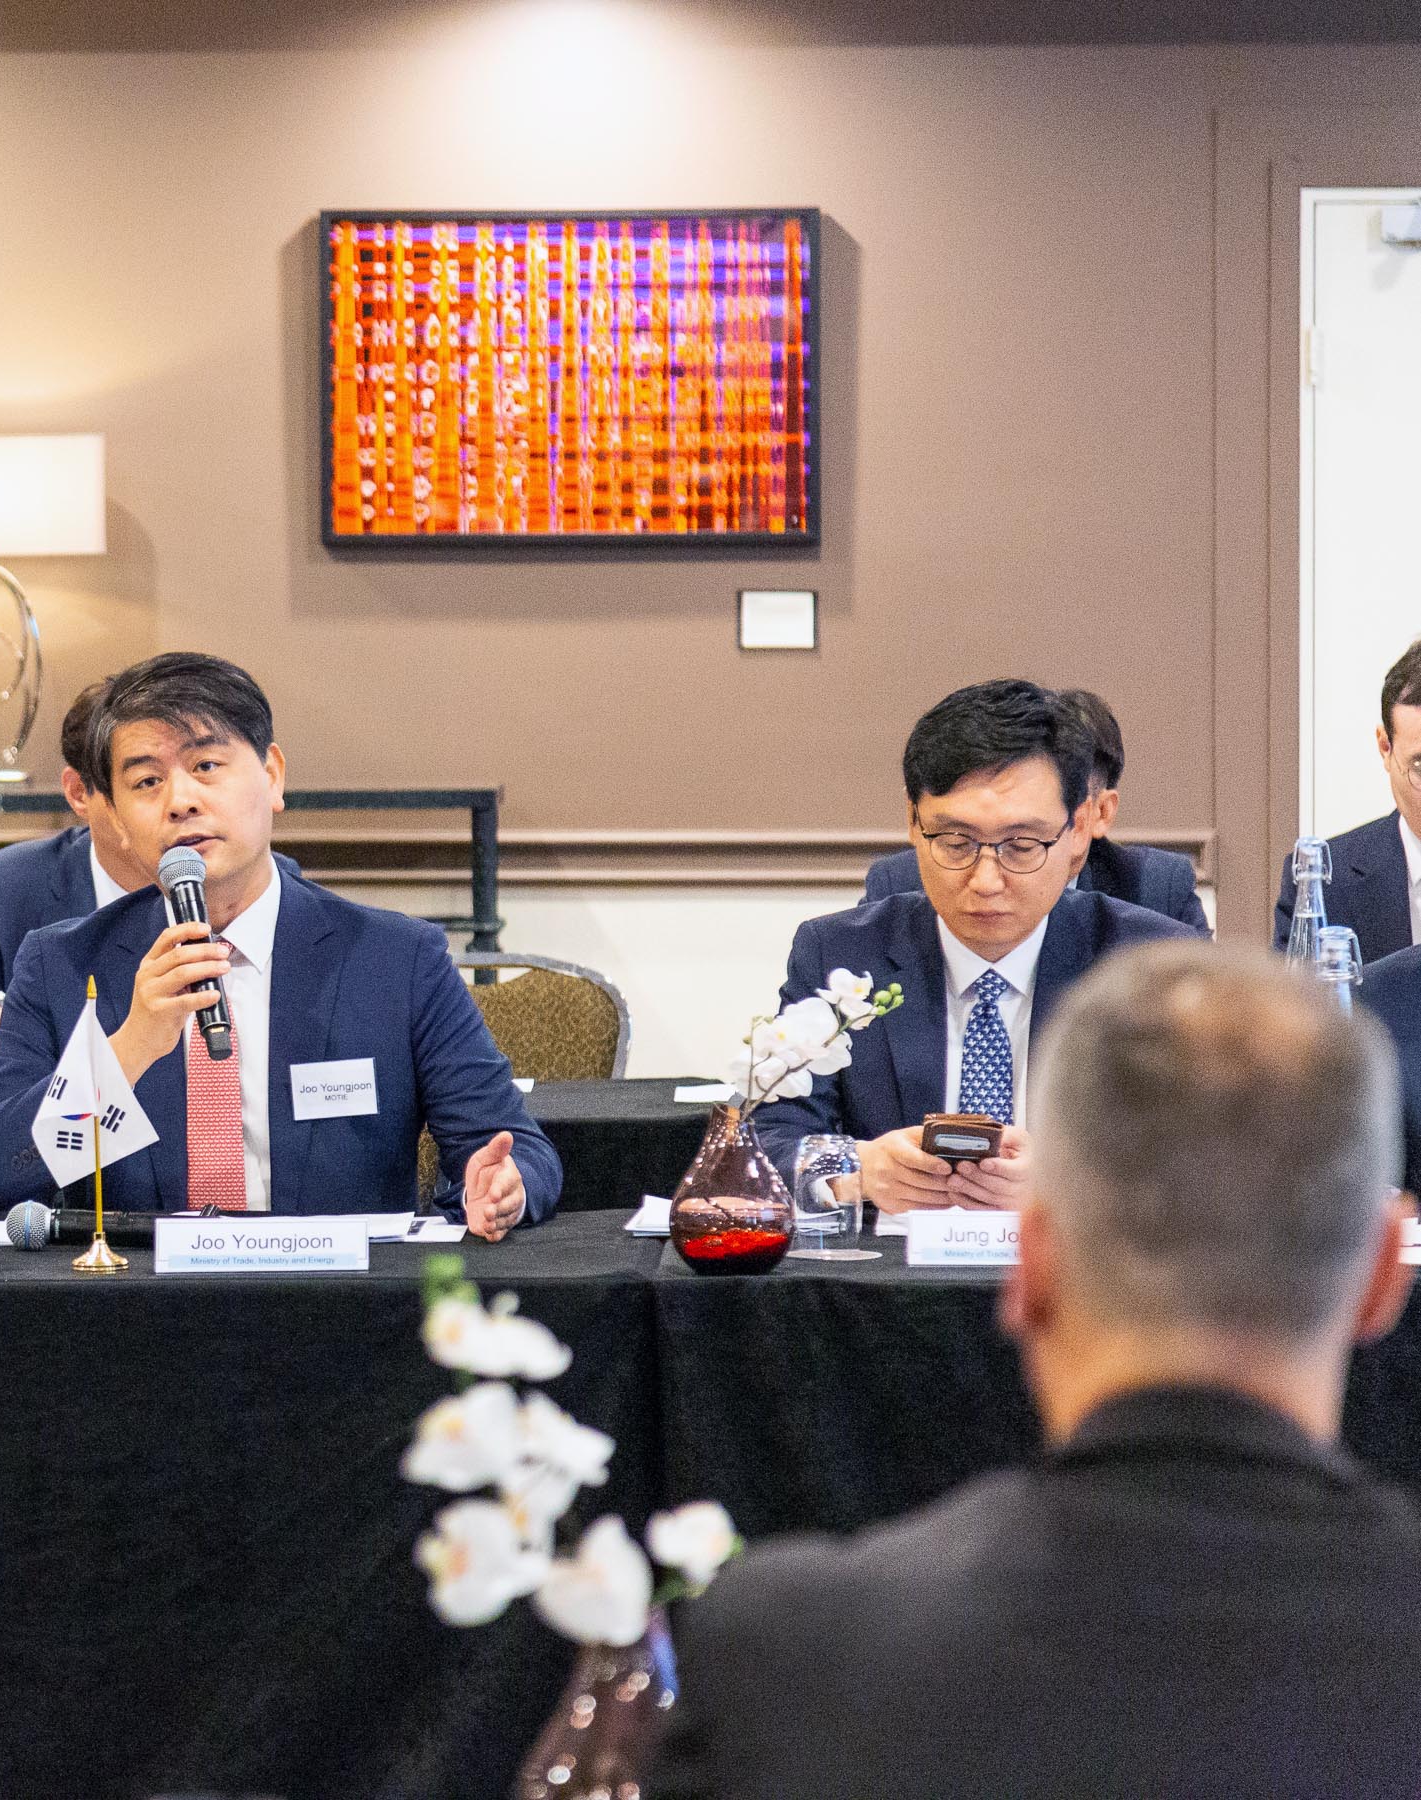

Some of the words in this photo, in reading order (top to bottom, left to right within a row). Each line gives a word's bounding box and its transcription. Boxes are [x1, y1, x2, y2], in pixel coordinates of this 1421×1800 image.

[300, 1085, 318, 1094] Joo
[320, 1083, 372, 1093] Youngjoon
[191, 1234, 225, 1250] Joo
[232, 1233, 333, 1253] Youngjoon
[943, 1227, 989, 1246] Jung
[190, 1256, 221, 1266] Ministry
[222, 1256, 231, 1265] of
[258, 1256, 289, 1265] Industry
[291, 1256, 307, 1264] and
[308, 1256, 335, 1265] Energy
